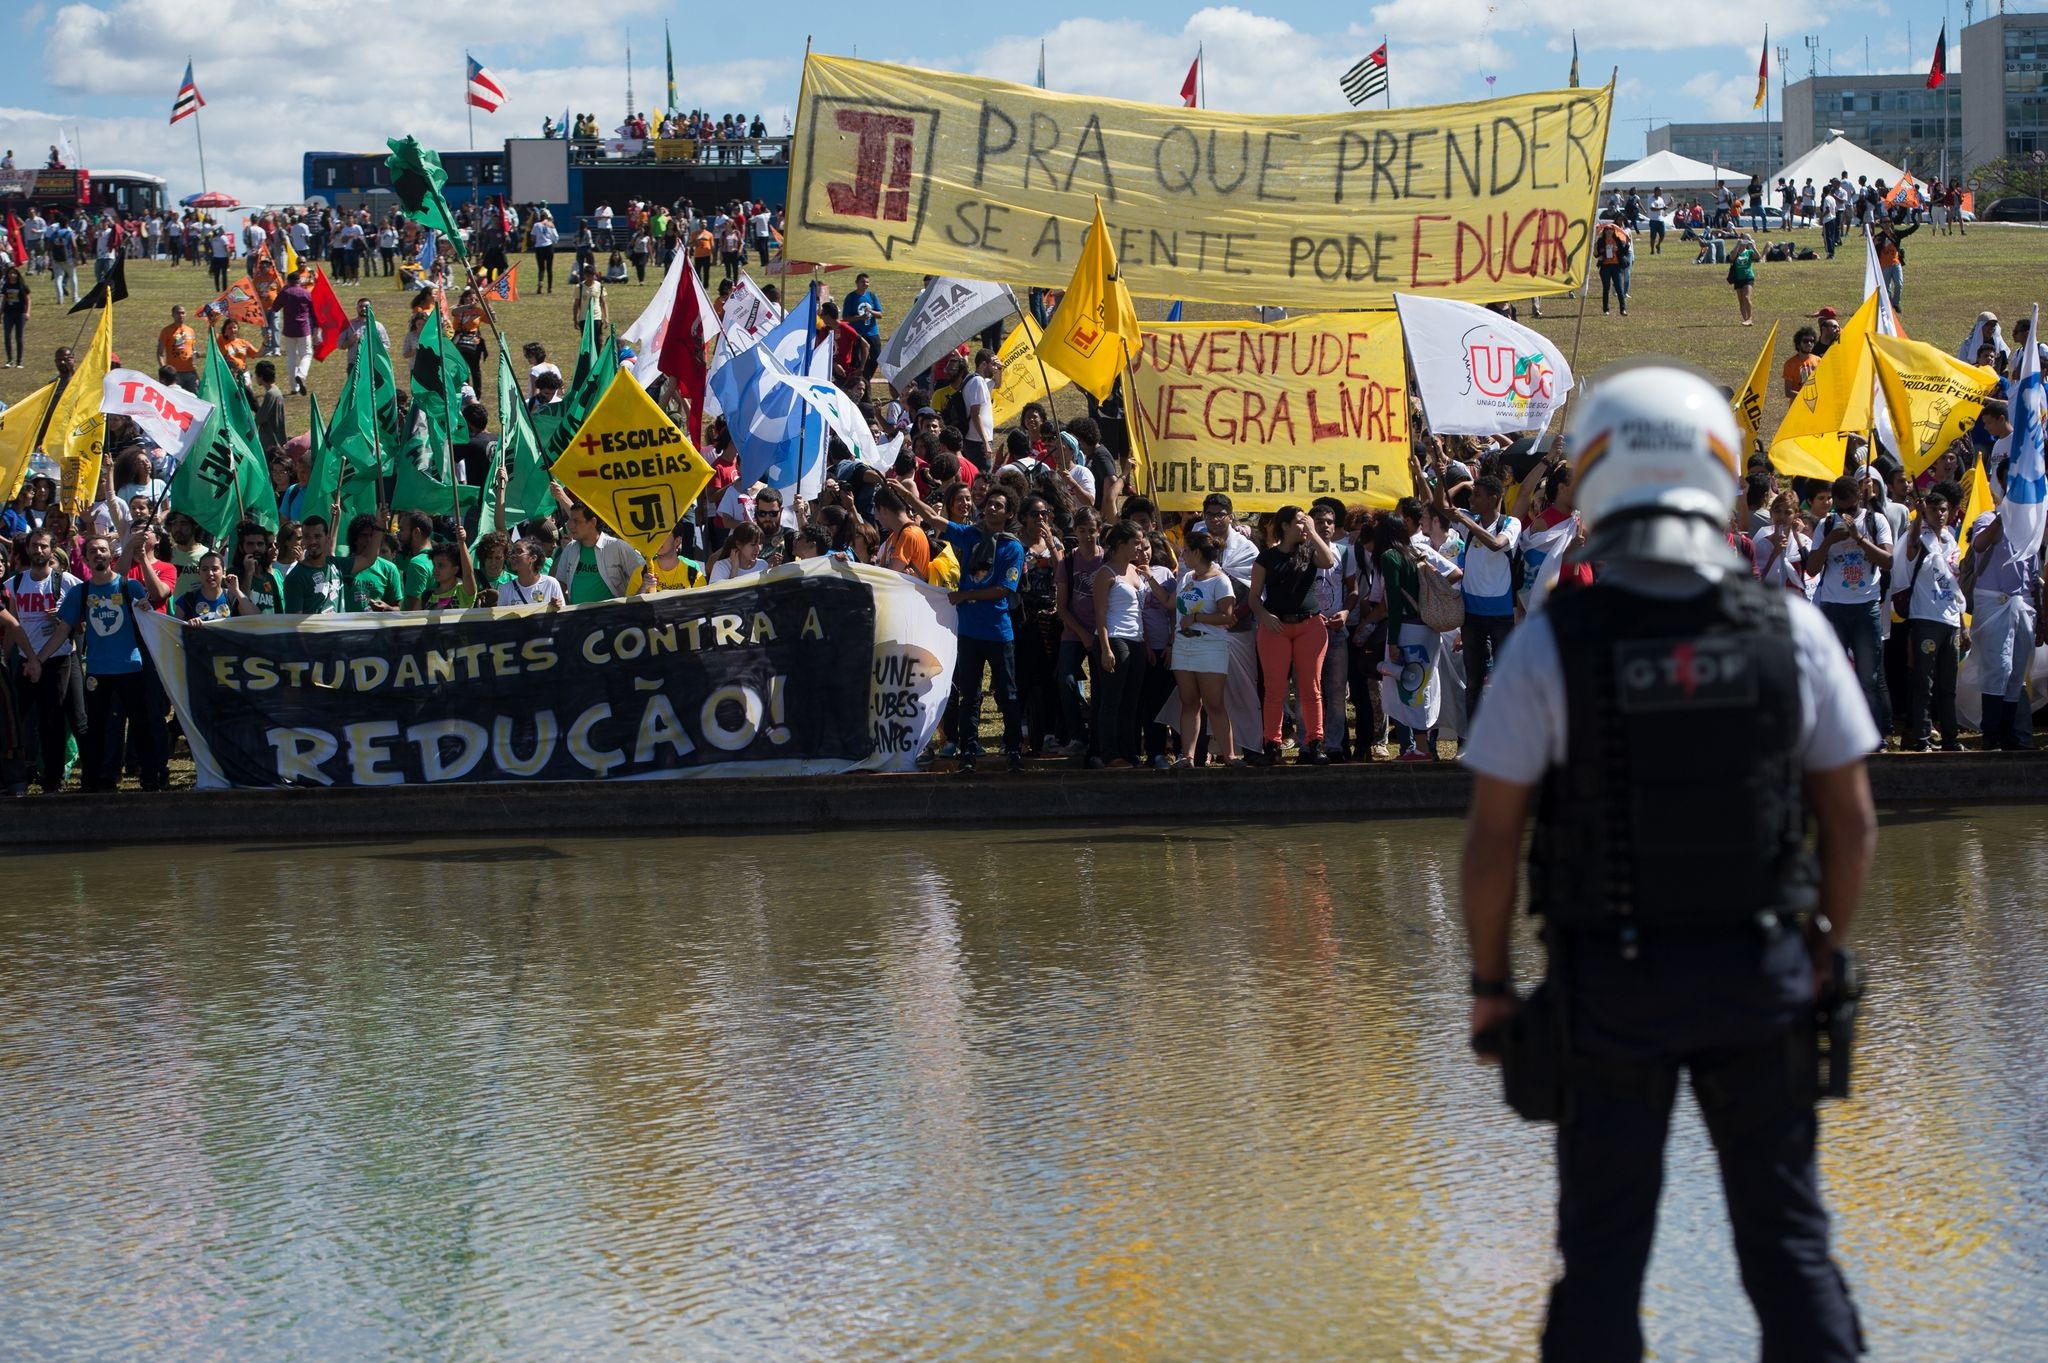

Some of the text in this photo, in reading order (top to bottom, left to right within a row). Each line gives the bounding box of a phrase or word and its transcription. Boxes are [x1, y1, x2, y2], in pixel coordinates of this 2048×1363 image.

[973, 99, 1116, 202] PRA
[1155, 126, 1300, 200] QUE
[946, 201, 1009, 253] SE
[1032, 216, 1062, 262] A
[1288, 231, 1398, 282] PODE
[1131, 330, 1369, 379] JUVENTUDE
[1132, 385, 1296, 446] NEGRA
[1946, 386, 1985, 406] PENA
[99, 610, 115, 619] UNE
[1182, 593, 1200, 601] UBES
[212, 606, 824, 691] ESTUDANTES CONTRA A
[265, 674, 791, 787] REDUÇÃO!
